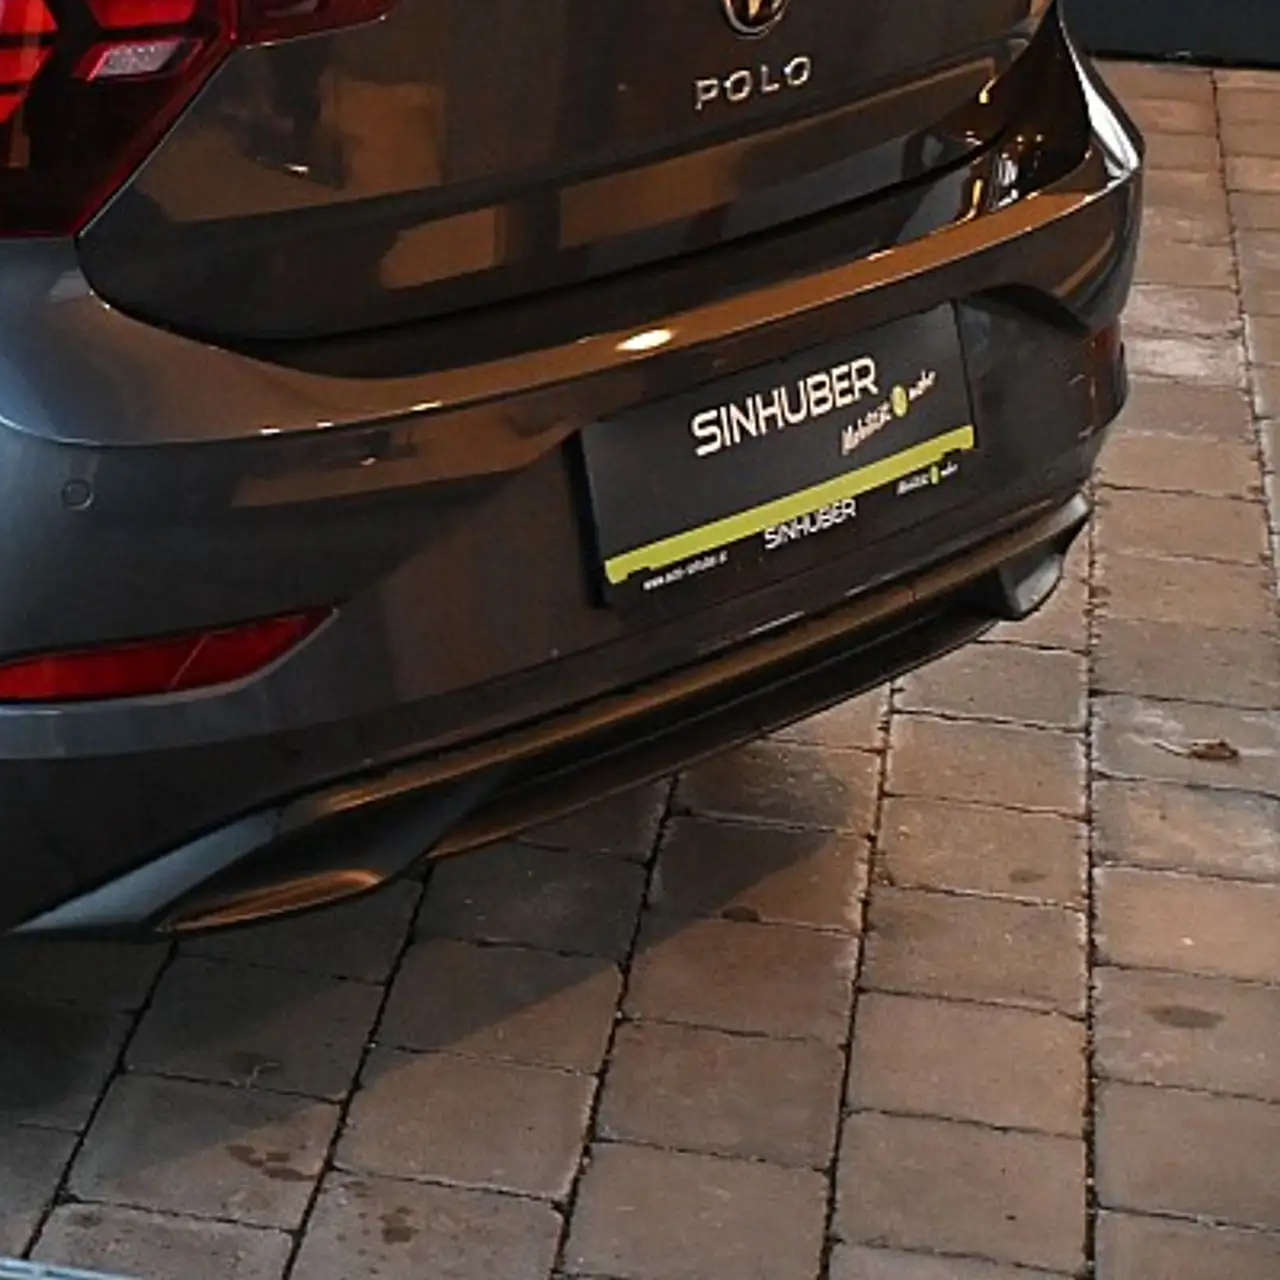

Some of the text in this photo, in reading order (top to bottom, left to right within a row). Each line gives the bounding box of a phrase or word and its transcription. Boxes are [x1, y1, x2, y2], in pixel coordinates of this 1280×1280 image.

[694, 56, 811, 110] POLO
[691, 356, 879, 457] SINHUBER
[763, 498, 857, 550] SINHUBER
